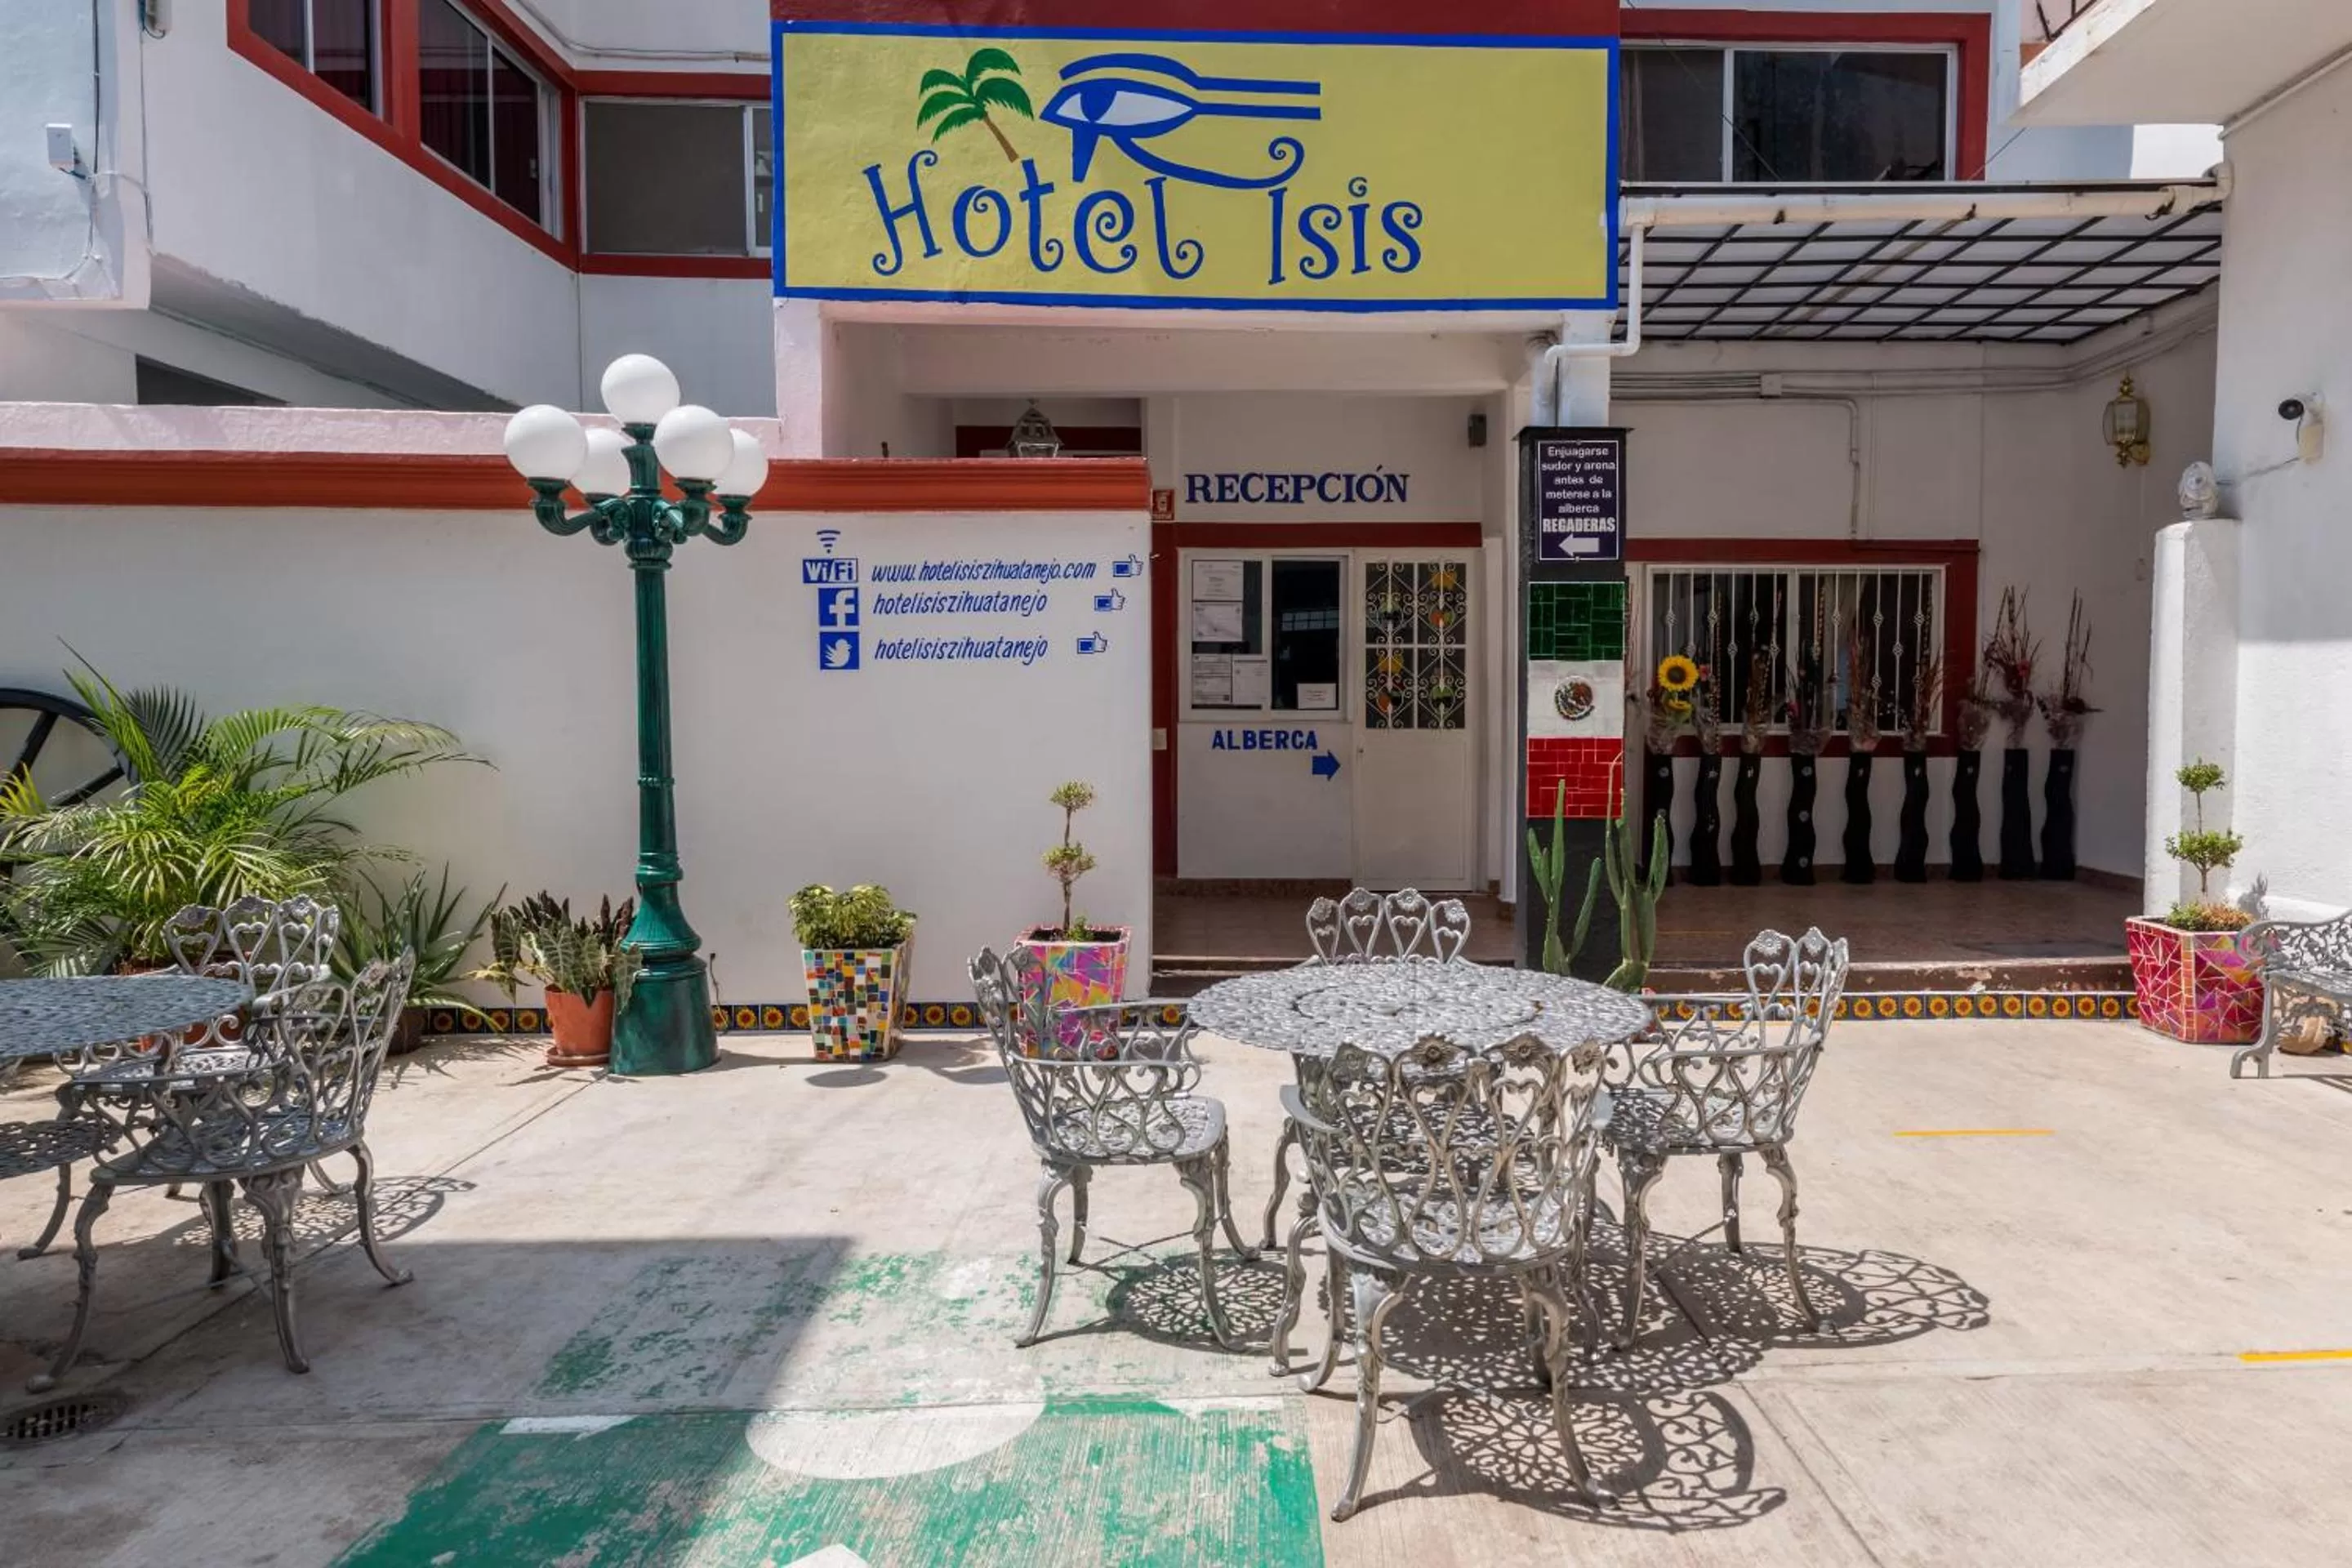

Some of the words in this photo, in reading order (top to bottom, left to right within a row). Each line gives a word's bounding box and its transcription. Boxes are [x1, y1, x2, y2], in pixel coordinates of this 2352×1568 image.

[863, 149, 1204, 279] Hotel
[1267, 176, 1423, 284] Isis
[1548, 446, 1610, 458] Enjuagarse
[1541, 461, 1573, 471] sudor
[1575, 463, 1581, 473] y
[1584, 462, 1615, 470] arena
[1185, 465, 1410, 504] RECEPCIÓN
[1554, 476, 1584, 484] antes
[1588, 475, 1603, 483] de
[1545, 490, 1590, 499] meterse
[1601, 488, 1612, 498] la
[1557, 503, 1600, 513] alberca
[1543, 517, 1615, 532] REGADERAS
[873, 589, 1048, 617] hotelisiszihuatanejo
[874, 635, 1049, 666] hotelisiszihuatanejo
[1211, 729, 1318, 751] ALBERCA
